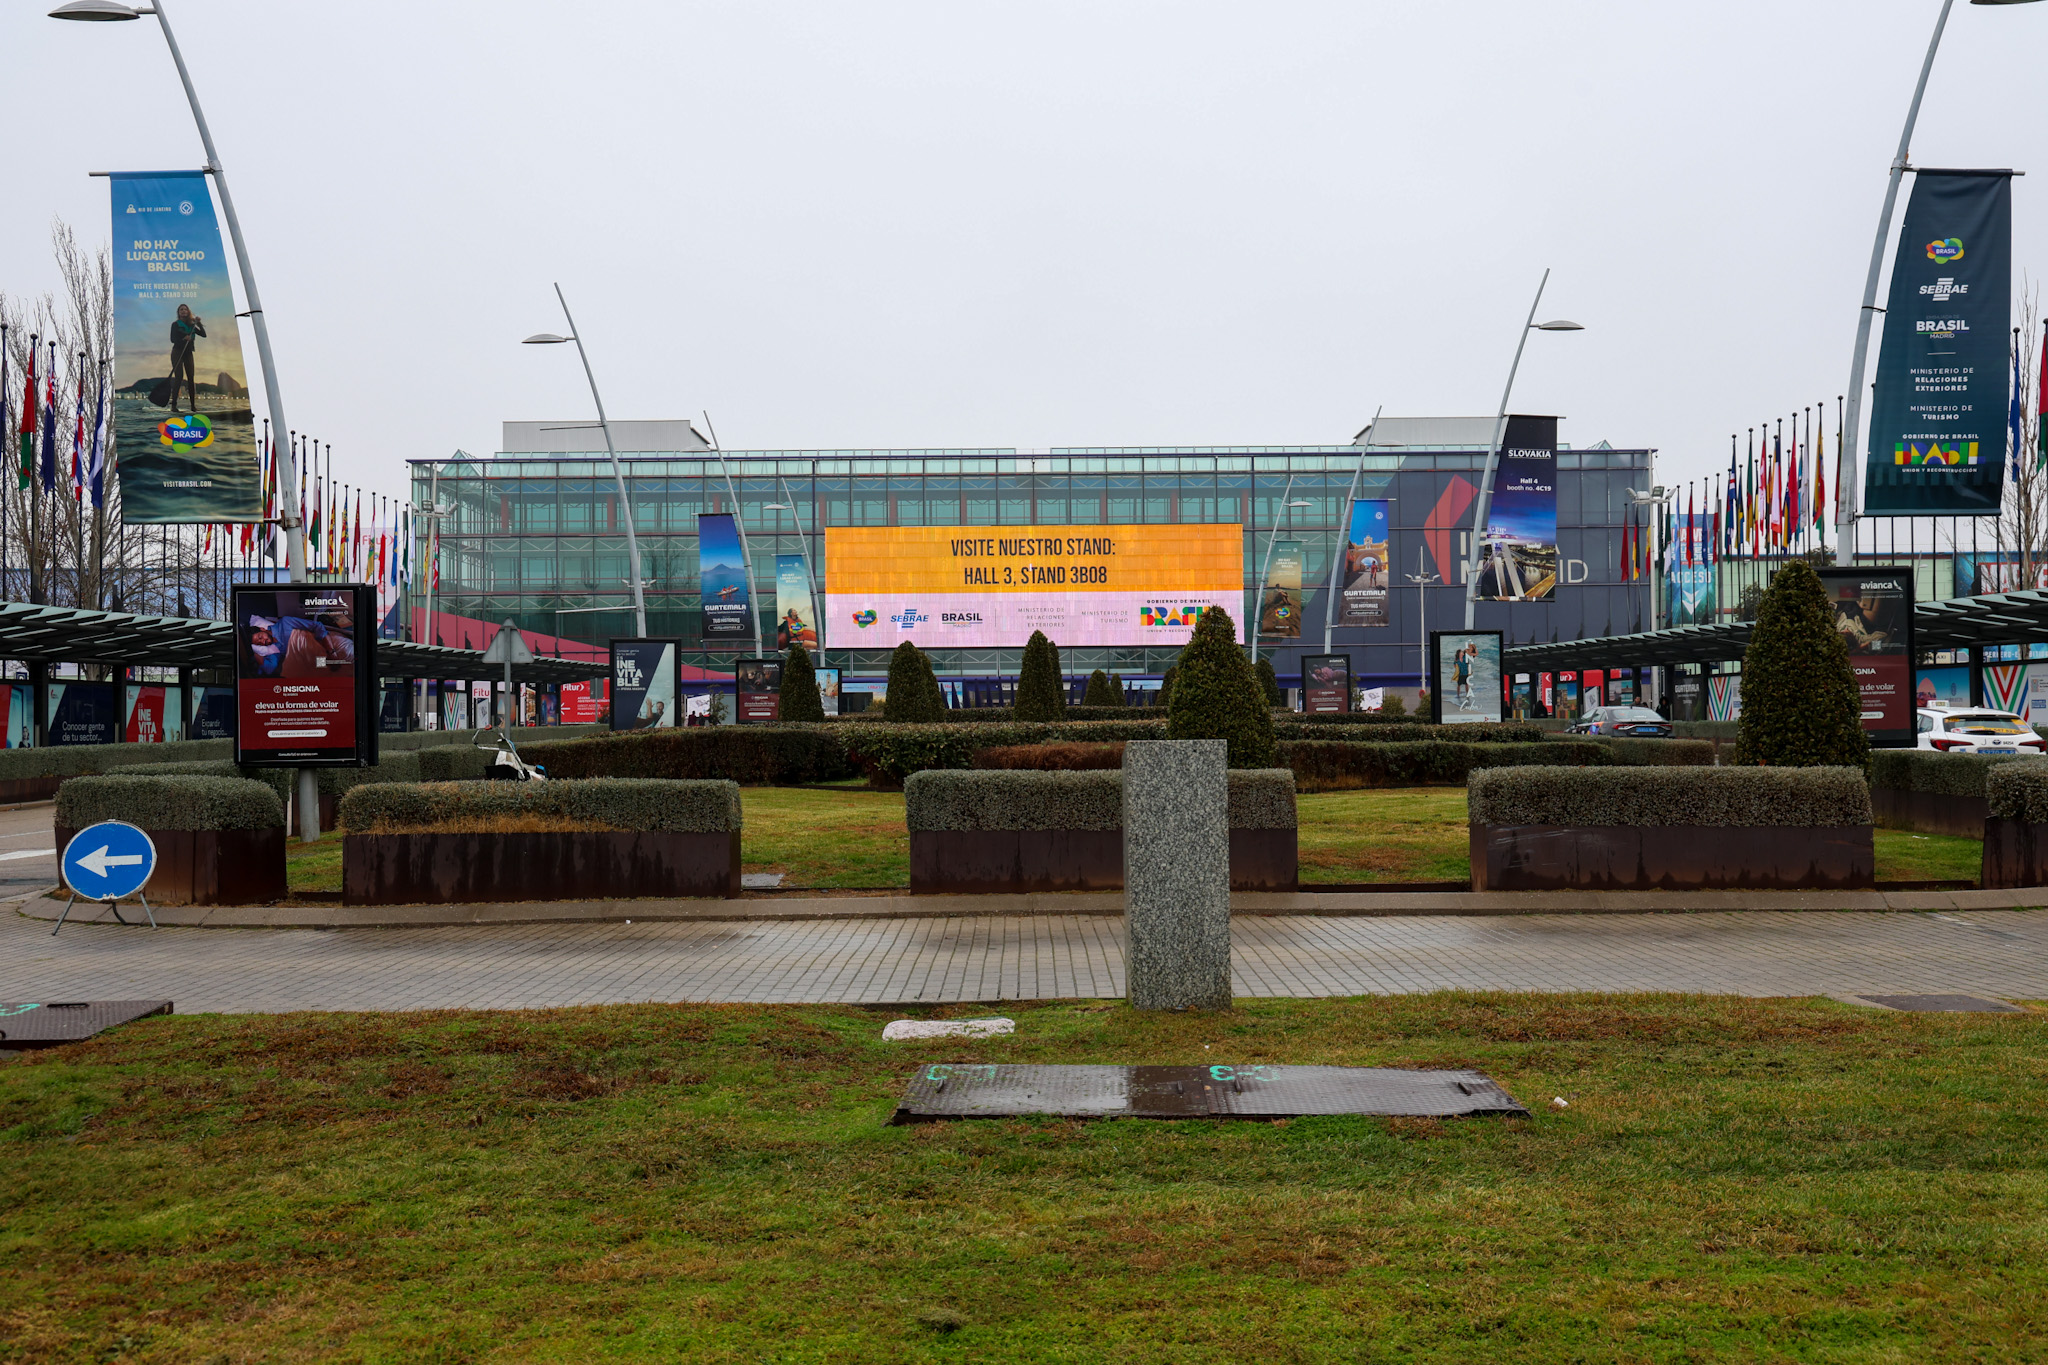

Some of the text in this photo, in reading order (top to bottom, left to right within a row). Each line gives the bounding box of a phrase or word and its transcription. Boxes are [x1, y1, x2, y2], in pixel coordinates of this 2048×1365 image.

[134, 240, 179, 249] NO HAY
[127, 251, 205, 260] LUGAR COMO
[148, 262, 191, 272] BRASIL
[1919, 285, 1968, 294] SEBRAE
[1916, 320, 1970, 331] BRASIL
[1508, 449, 1552, 458] SLOVAKIA
[1895, 442, 1986, 465] BRASIL
[951, 538, 1116, 556] VISITE NUESTRO STAND:
[964, 566, 1107, 586] HALL 3, STAND 3B08
[1860, 581, 1892, 589] avianca
[305, 597, 338, 605] avianca
[942, 613, 982, 621] BRASIL
[617, 660, 635, 668] INE
[617, 669, 643, 678] VITA
[617, 678, 640, 686] BLE
[138, 709, 151, 721] INE
[62, 721, 105, 734] Conocer gente
[138, 722, 156, 734] VITA
[202, 719, 220, 729] Expandir
[62, 732, 70, 741] de
